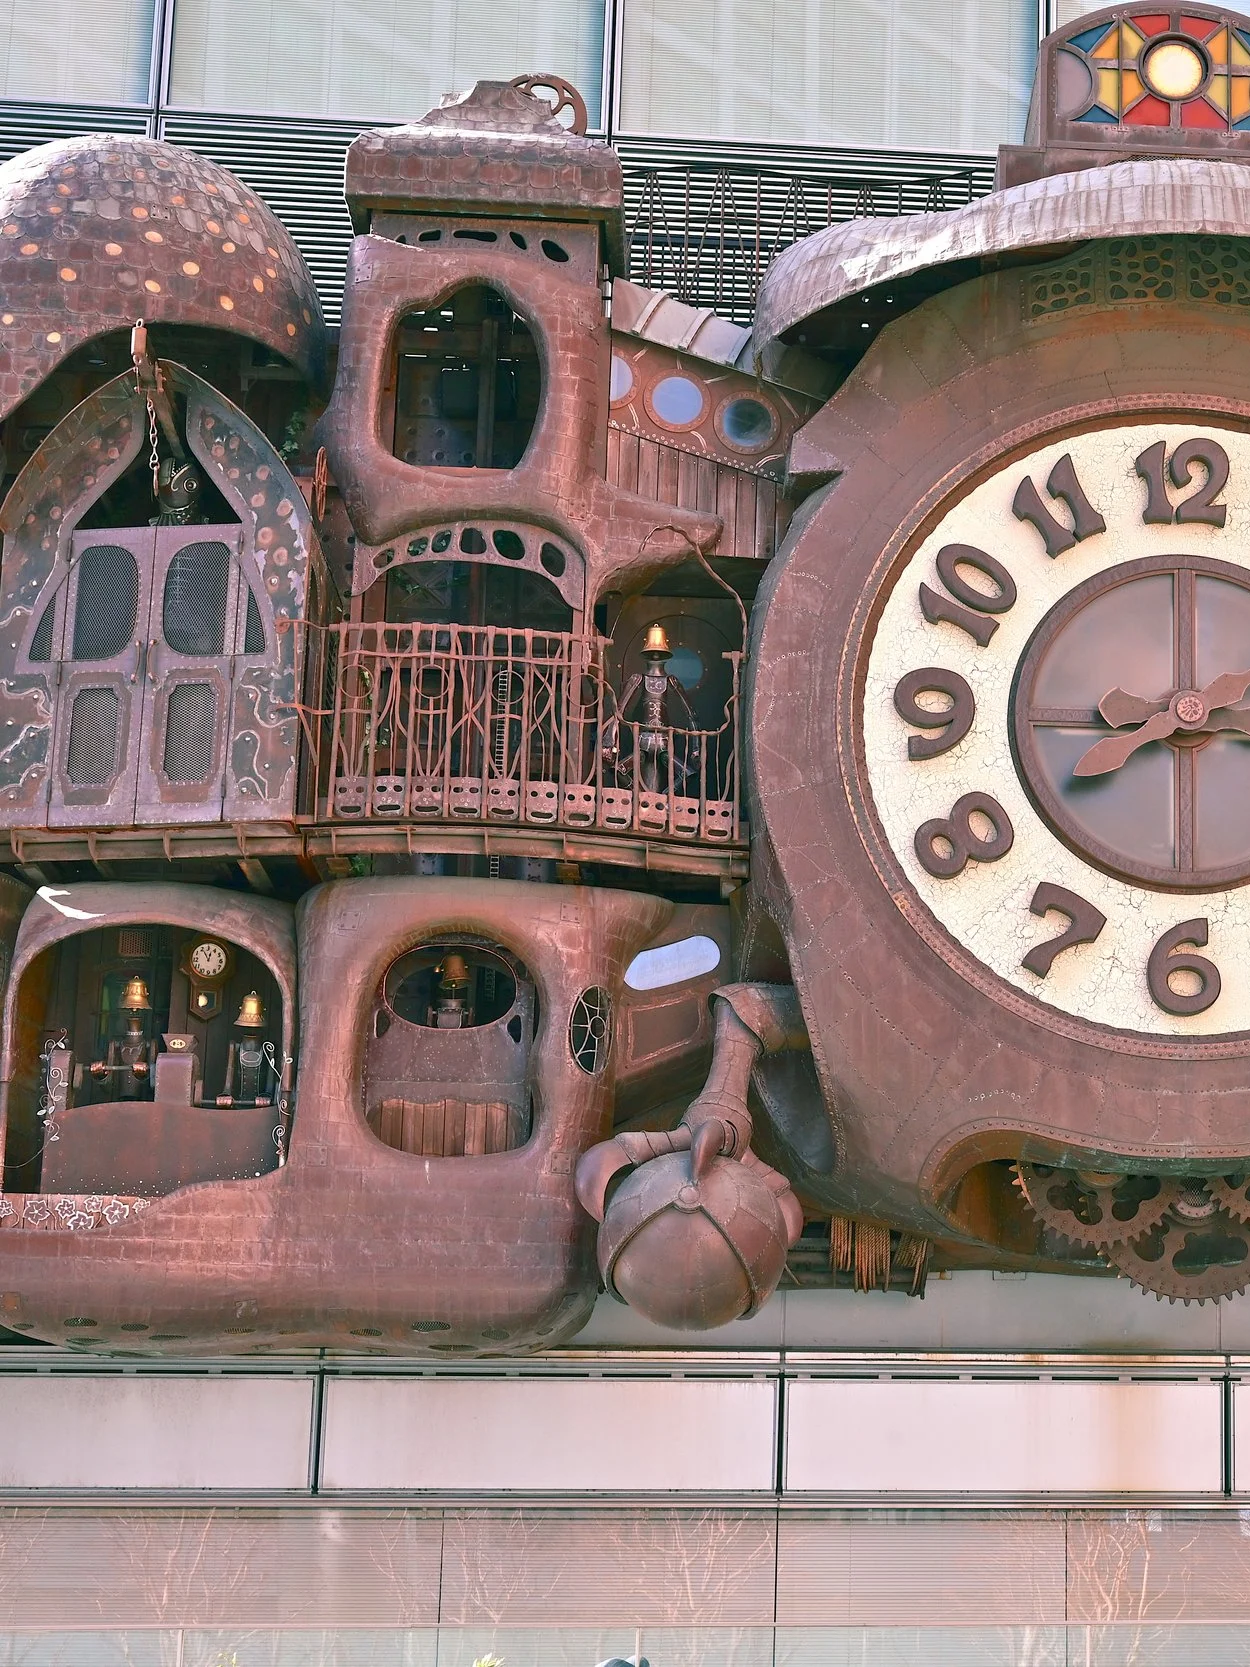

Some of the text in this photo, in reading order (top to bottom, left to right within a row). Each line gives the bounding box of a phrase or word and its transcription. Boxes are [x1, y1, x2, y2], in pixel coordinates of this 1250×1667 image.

[1012, 453, 1106, 558] 11
[1135, 438, 1230, 528] 12
[919, 543, 1017, 648] 10
[894, 667, 975, 762] 9
[914, 791, 1014, 880] 8
[1021, 882, 1107, 979] 7
[1146, 917, 1221, 1017] 6
